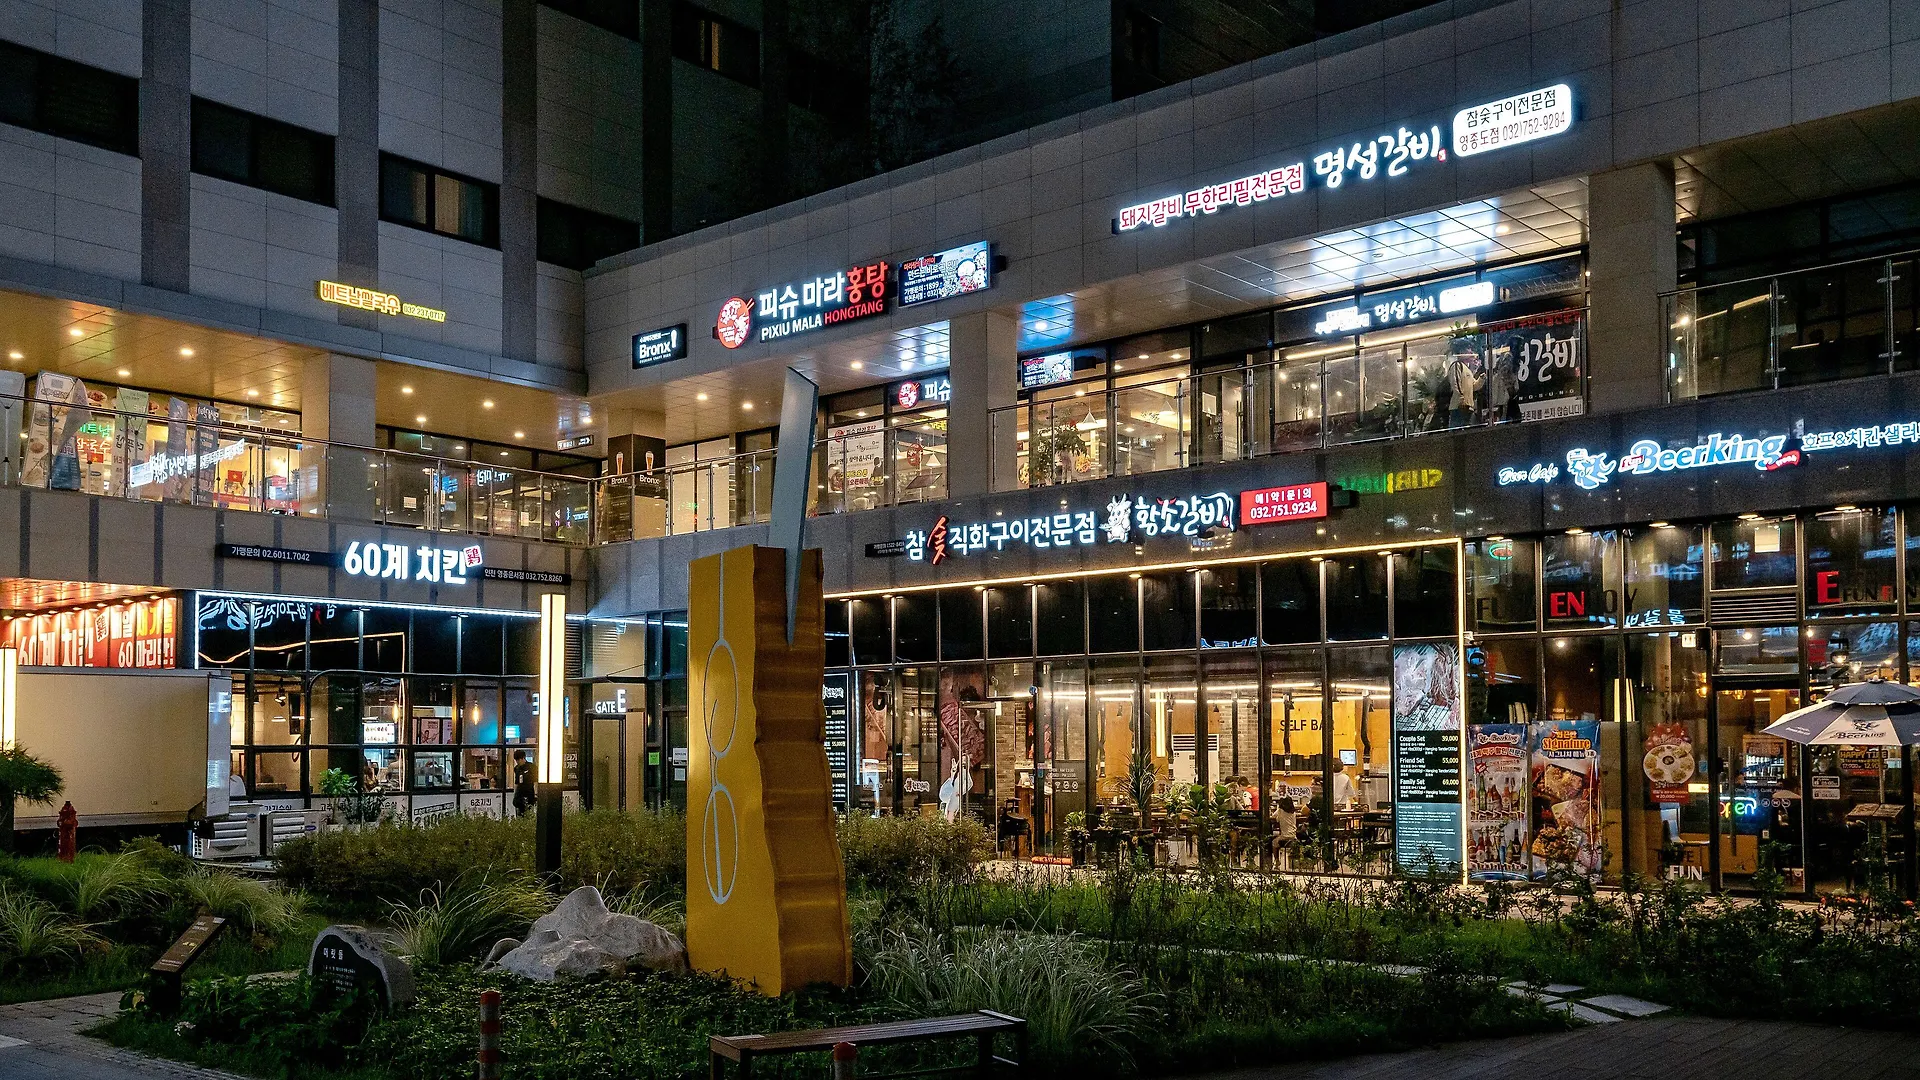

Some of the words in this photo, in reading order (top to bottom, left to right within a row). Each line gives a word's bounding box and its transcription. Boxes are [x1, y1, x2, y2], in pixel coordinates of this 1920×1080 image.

[1467, 89, 1556, 128] 참숯구이전문점
[1459, 126, 1500, 151] 영종도점
[1314, 126, 1439, 188] 명성갈비
[1121, 197, 1181, 228] 돼지갈비
[1185, 166, 1302, 214] 무한리필전문점
[759, 285, 799, 319] 피슈
[761, 323, 790, 341] PIXIU
[793, 314, 822, 333] MALA
[824, 299, 883, 325] HONGTANG
[640, 341, 671, 359] Bronx
[924, 380, 950, 401] 피슈
[1633, 434, 1785, 479] Beerking
[639, 474, 659, 485] Bronx
[1500, 467, 1527, 486] Beer
[1528, 463, 1559, 483] Cafe
[1250, 501, 1317, 520] 032.751.9234
[232, 546, 260, 558] 가맹문의
[262, 547, 310, 562] 02.6011.7042
[344, 541, 408, 580] 60계
[416, 546, 467, 585] 치킨
[595, 701, 615, 713] GATE
[616, 689, 626, 713] E
[1280, 719, 1307, 732] SELF
[1542, 738, 1590, 750] Signature
[1840, 751, 1865, 759] HAPPY
[1670, 865, 1702, 880] FUN
